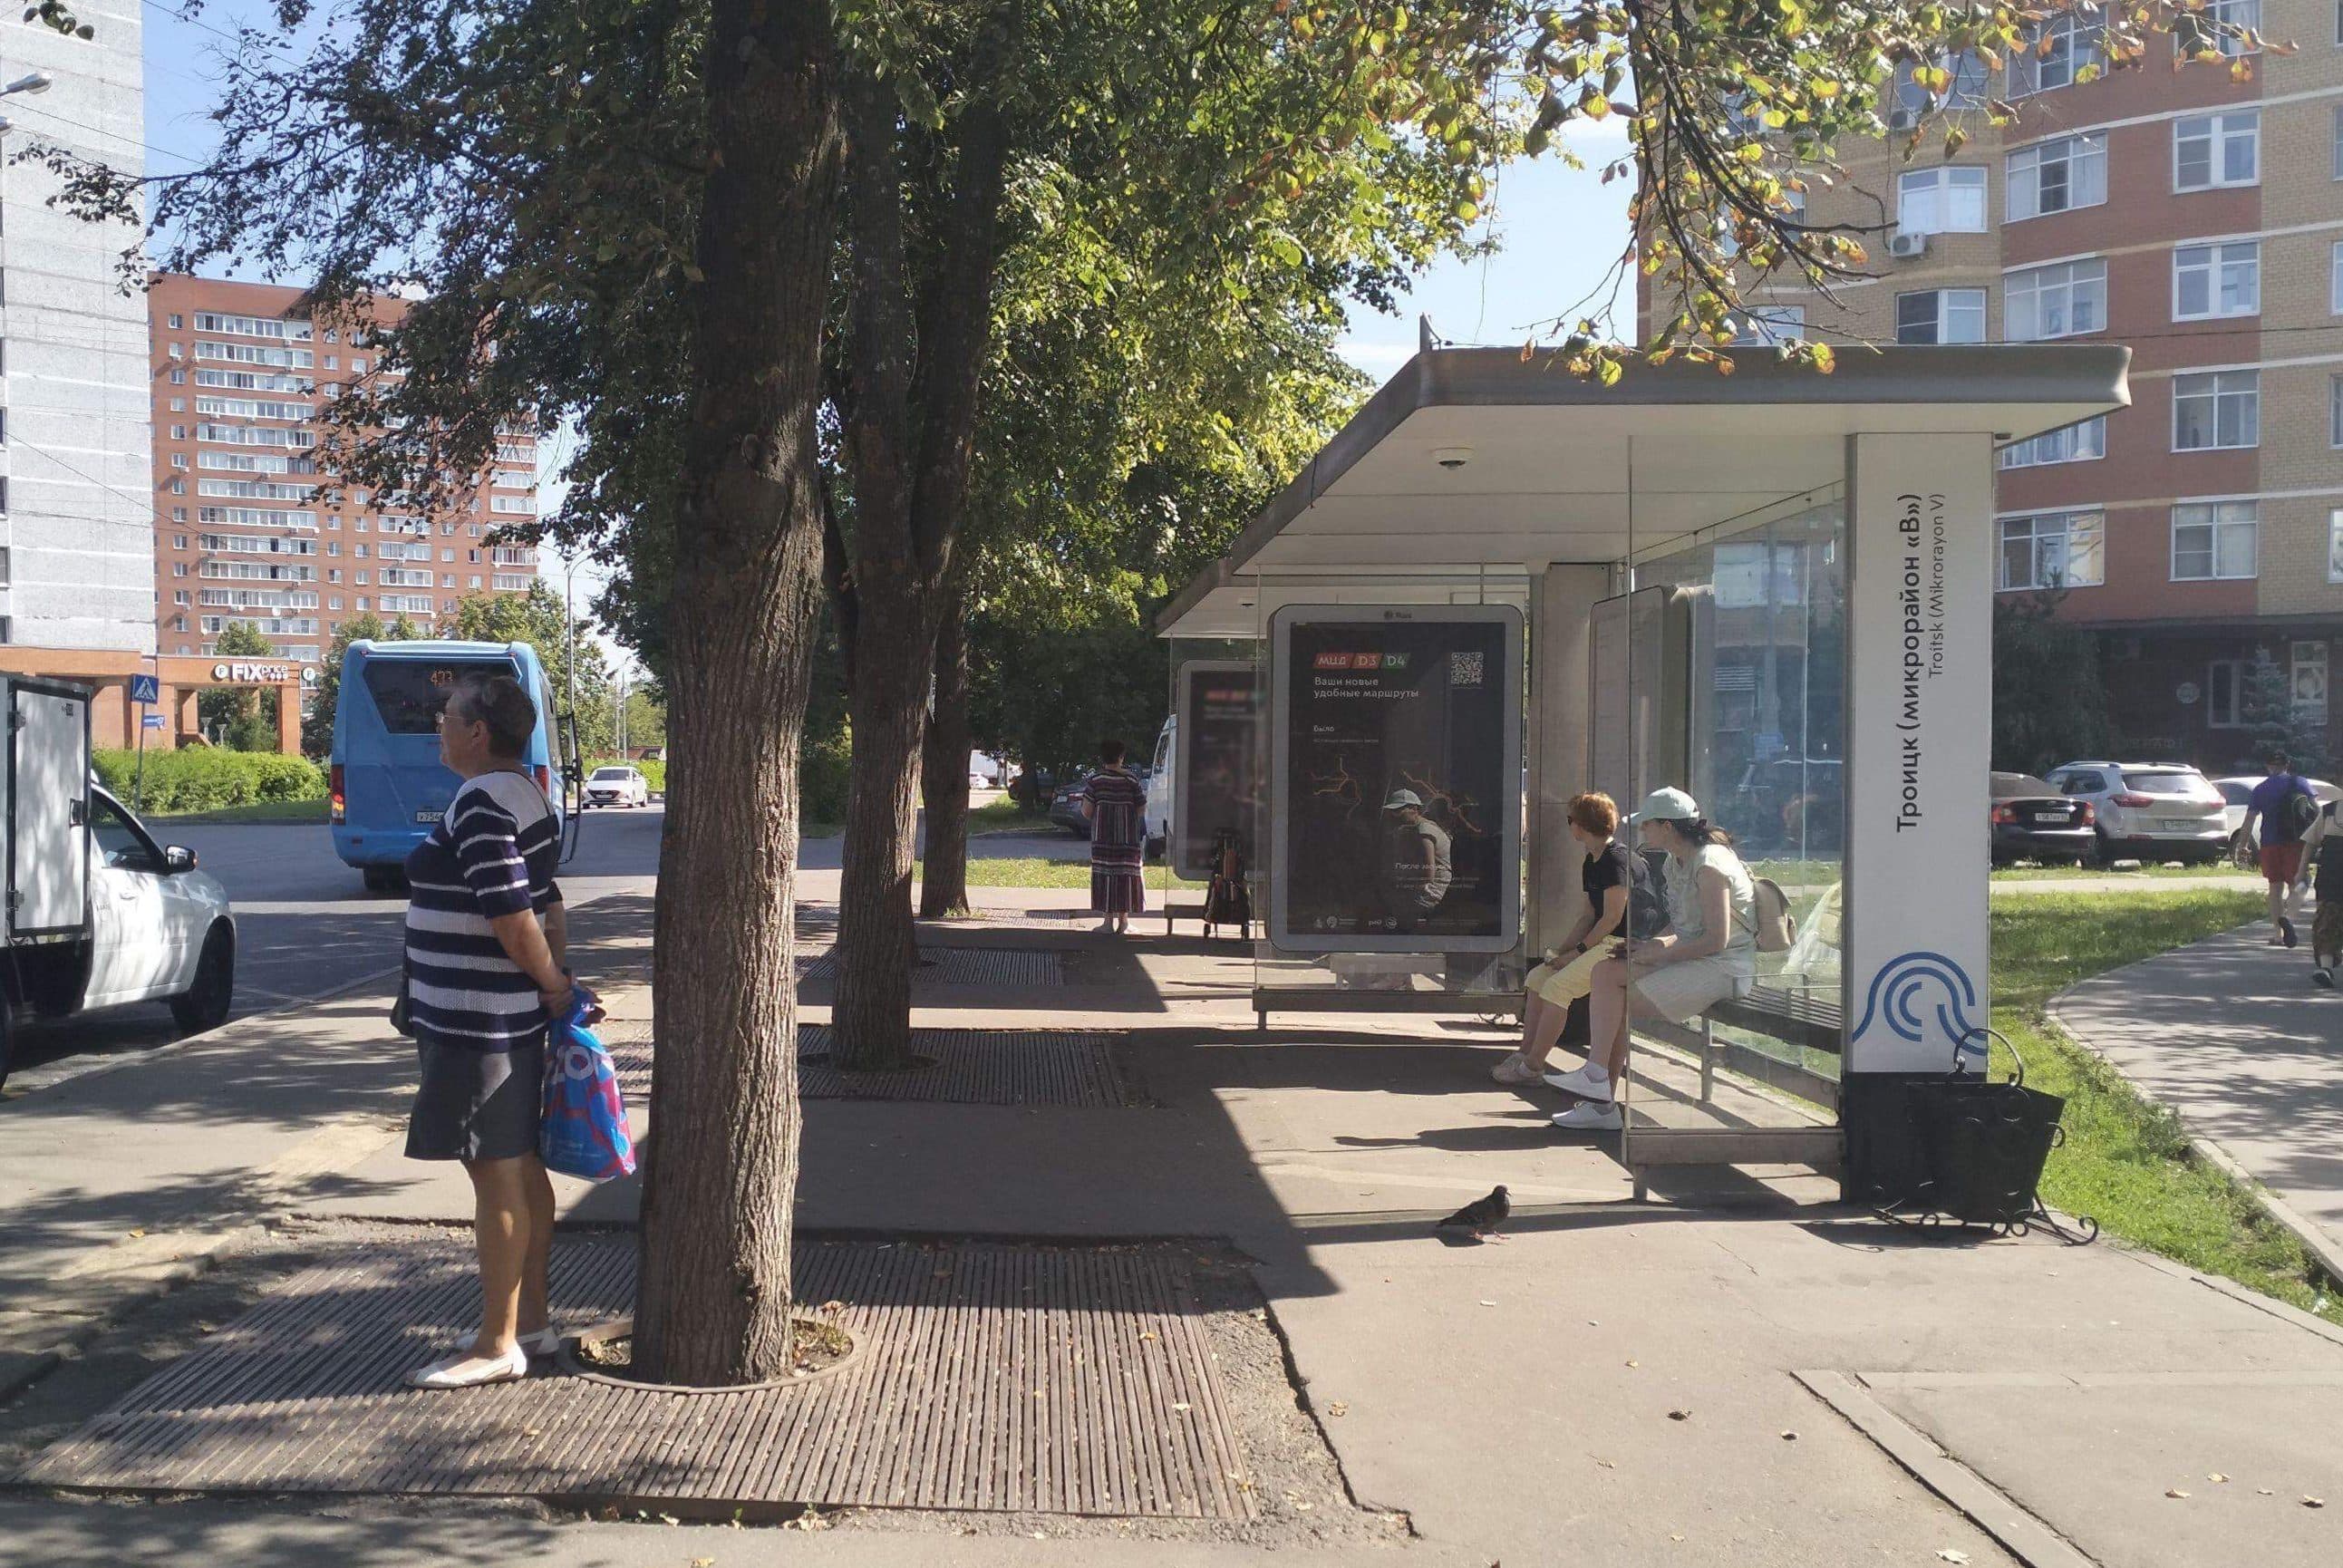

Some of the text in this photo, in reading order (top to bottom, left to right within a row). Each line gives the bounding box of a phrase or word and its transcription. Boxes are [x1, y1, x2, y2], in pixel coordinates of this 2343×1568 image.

[1928, 494, 1948, 679] Troitsk (Mikrorayon V)
[1358, 655, 1377, 666] D3
[1387, 654, 1407, 666] D4
[1896, 494, 1925, 834] Троицк (микрорайон «В»)
[232, 663, 263, 681] FIX
[1314, 676, 1379, 686] Ваши новые
[1313, 688, 1419, 700] удобные маршруты
